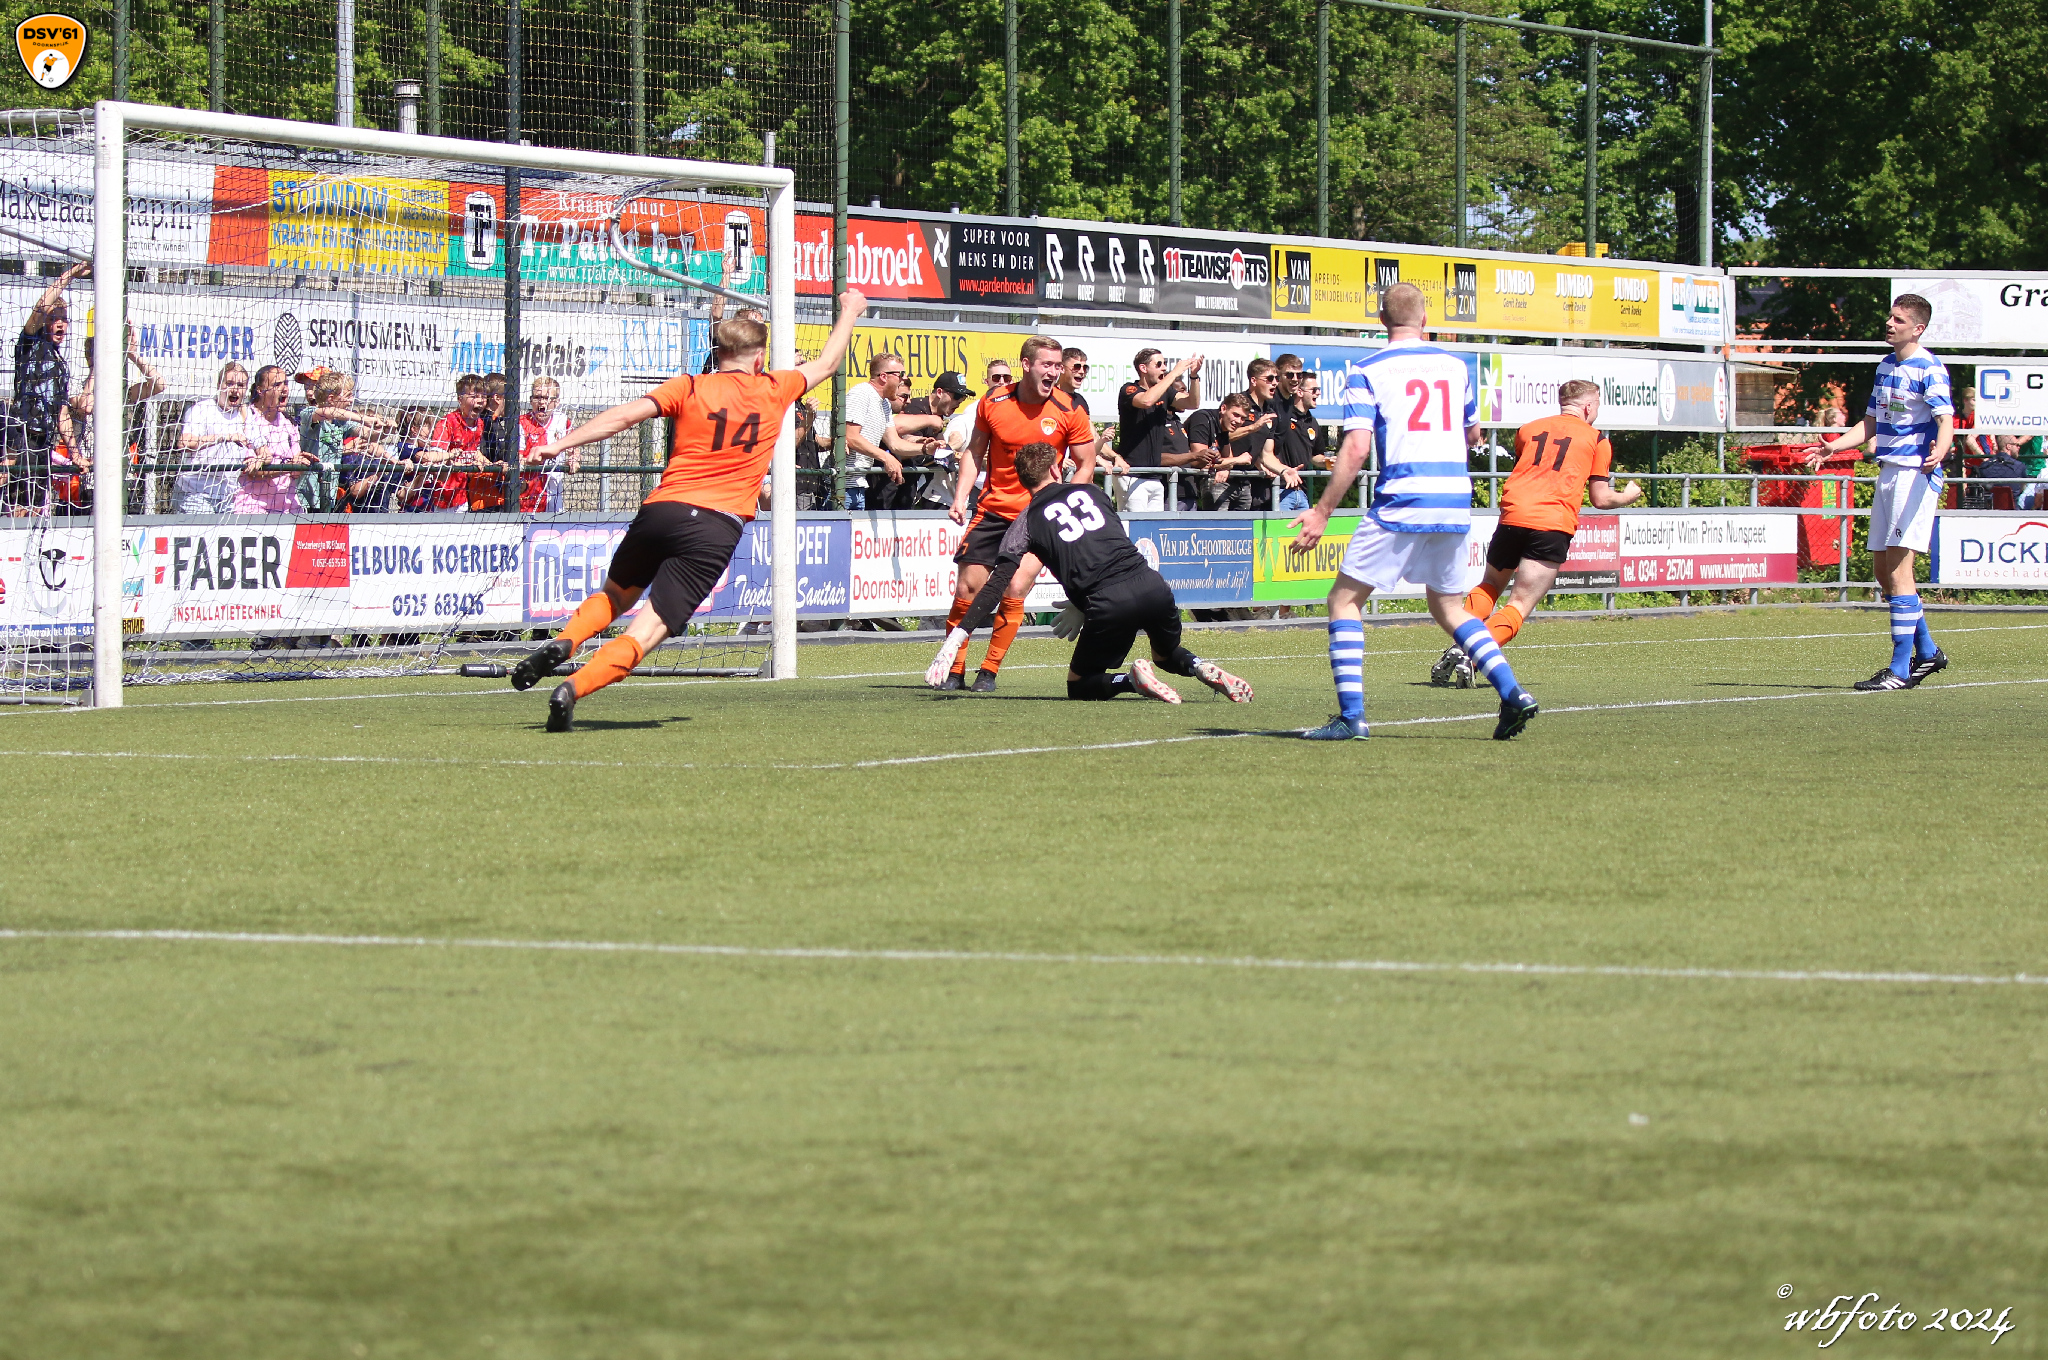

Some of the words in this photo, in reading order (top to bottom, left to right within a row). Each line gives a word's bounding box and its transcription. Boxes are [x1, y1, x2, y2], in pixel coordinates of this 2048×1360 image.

[273, 180, 388, 218] STOUWDAM
[558, 194, 665, 218] Kraanvhuur
[963, 227, 997, 246] SUPER
[1001, 230, 1031, 248] VOOR
[795, 227, 925, 287] ardnbroek
[958, 251, 986, 269] MENS
[993, 255, 1005, 269] EN
[1010, 257, 1034, 272] DIER
[1290, 259, 1310, 281] VAN
[959, 276, 1034, 297] www.gardenbroek.nl
[1379, 266, 1398, 287] VAN
[1457, 270, 1476, 291] VAN
[1495, 269, 1536, 296] JUMBO
[1555, 272, 1593, 299] JUMBO
[1613, 276, 1649, 303] JUMBO
[1290, 286, 1310, 306] ZON
[1458, 294, 1476, 315] ZON
[1672, 281, 1720, 310] BROUWER
[140, 323, 254, 361] MATEBOER
[309, 318, 441, 352] SERIOUSMEN.NL
[621, 319, 680, 372] KME
[1405, 379, 1452, 432] 21
[1602, 377, 1657, 411] Nieuwstad
[707, 407, 761, 454] 14
[1531, 430, 1573, 472] 11
[1043, 490, 1106, 543] 33
[751, 526, 832, 566] NUPEET
[854, 528, 932, 560] Bouwmarkt
[1624, 521, 1675, 550] Autobedrijf
[1677, 520, 1698, 544] Wim
[1701, 520, 1723, 544] Prins
[1726, 520, 1767, 548] Nunspeet
[172, 536, 281, 590] FABER
[352, 545, 422, 576] ELBURG
[432, 543, 518, 575] KOERIERS
[1623, 559, 1637, 582] tel.
[1638, 559, 1658, 582] 0341
[1666, 558, 1694, 582] 257041
[1699, 556, 1768, 583] www.wimprins.nl
[796, 576, 847, 609] Sanitair
[852, 572, 918, 604] Doornspijk
[925, 571, 942, 598] tel.
[172, 603, 282, 623] INSTALLATIETECHNIEK
[392, 593, 427, 617] 0525
[434, 592, 484, 617] 683426
